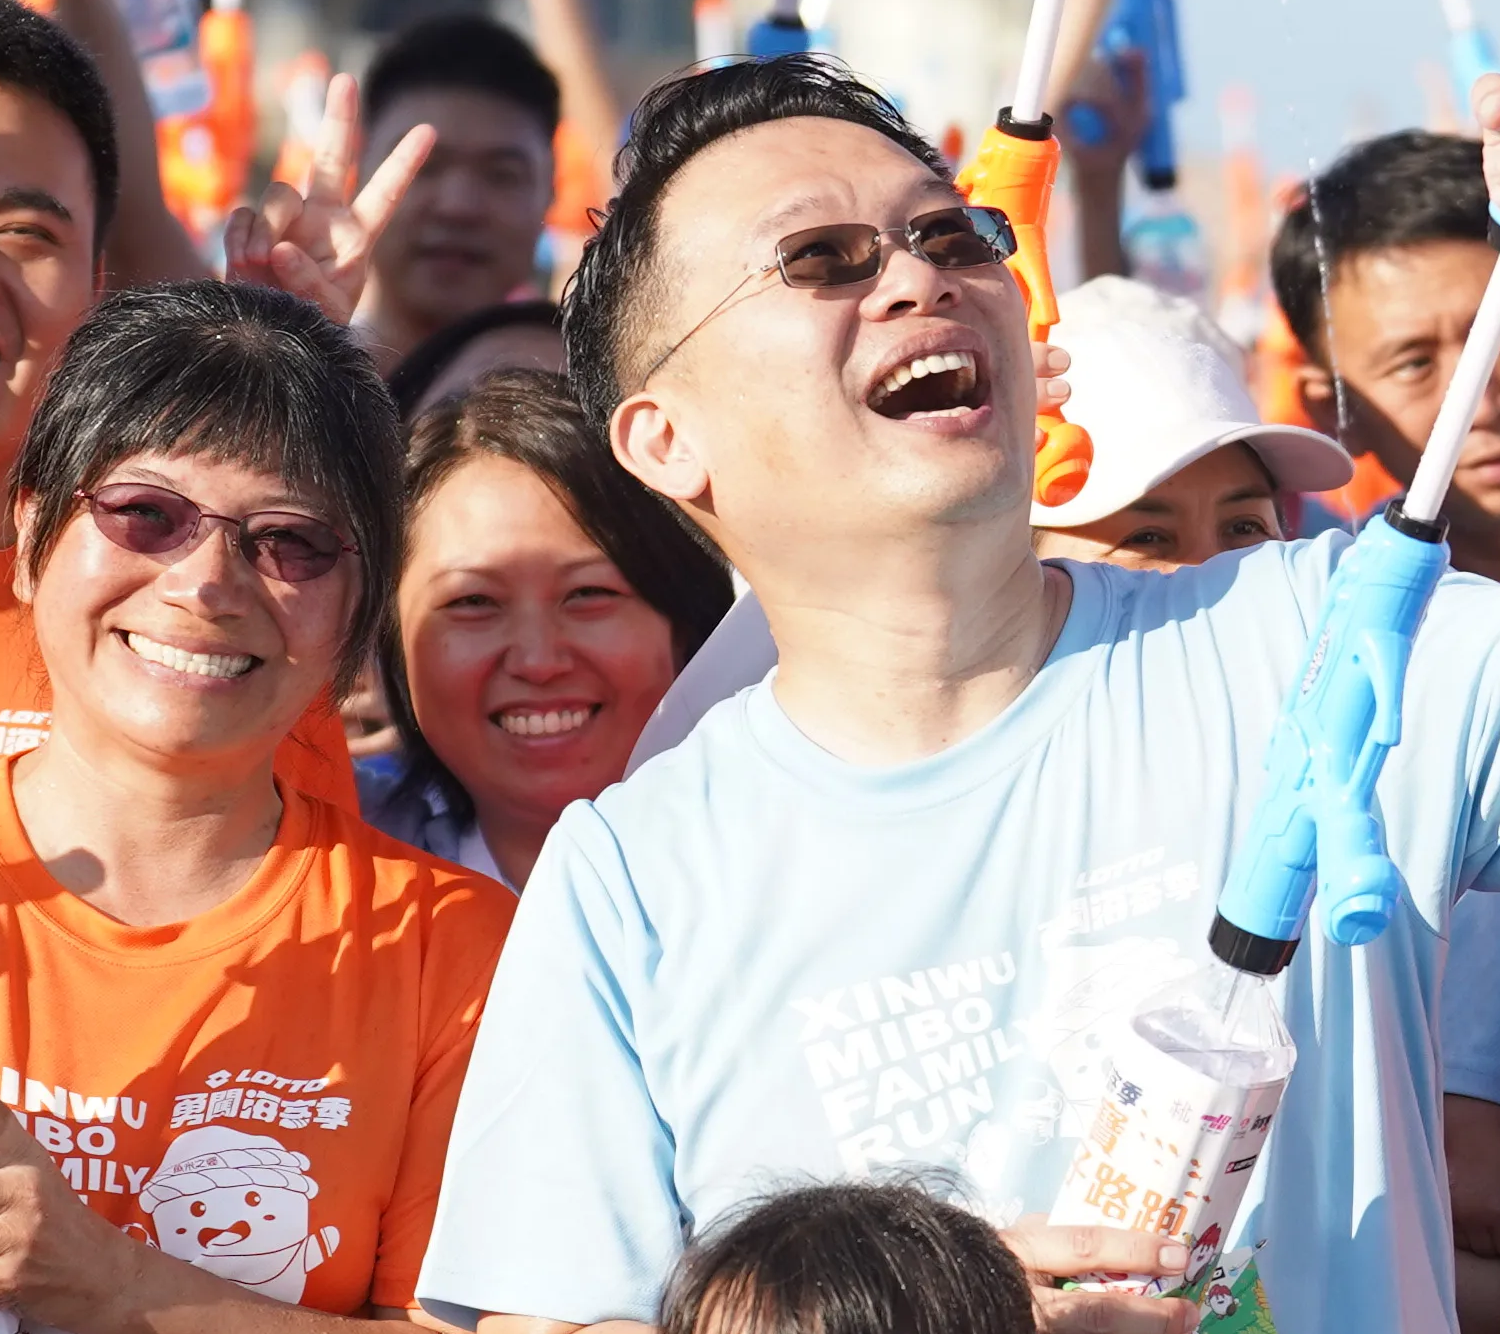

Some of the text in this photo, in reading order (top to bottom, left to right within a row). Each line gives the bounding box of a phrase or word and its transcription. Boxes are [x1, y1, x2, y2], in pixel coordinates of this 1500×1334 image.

[789, 951, 1017, 1043] XINWU
[236, 1069, 330, 1093] LOTTO
[804, 998, 993, 1090] MIBO
[838, 1077, 993, 1179] RUN
